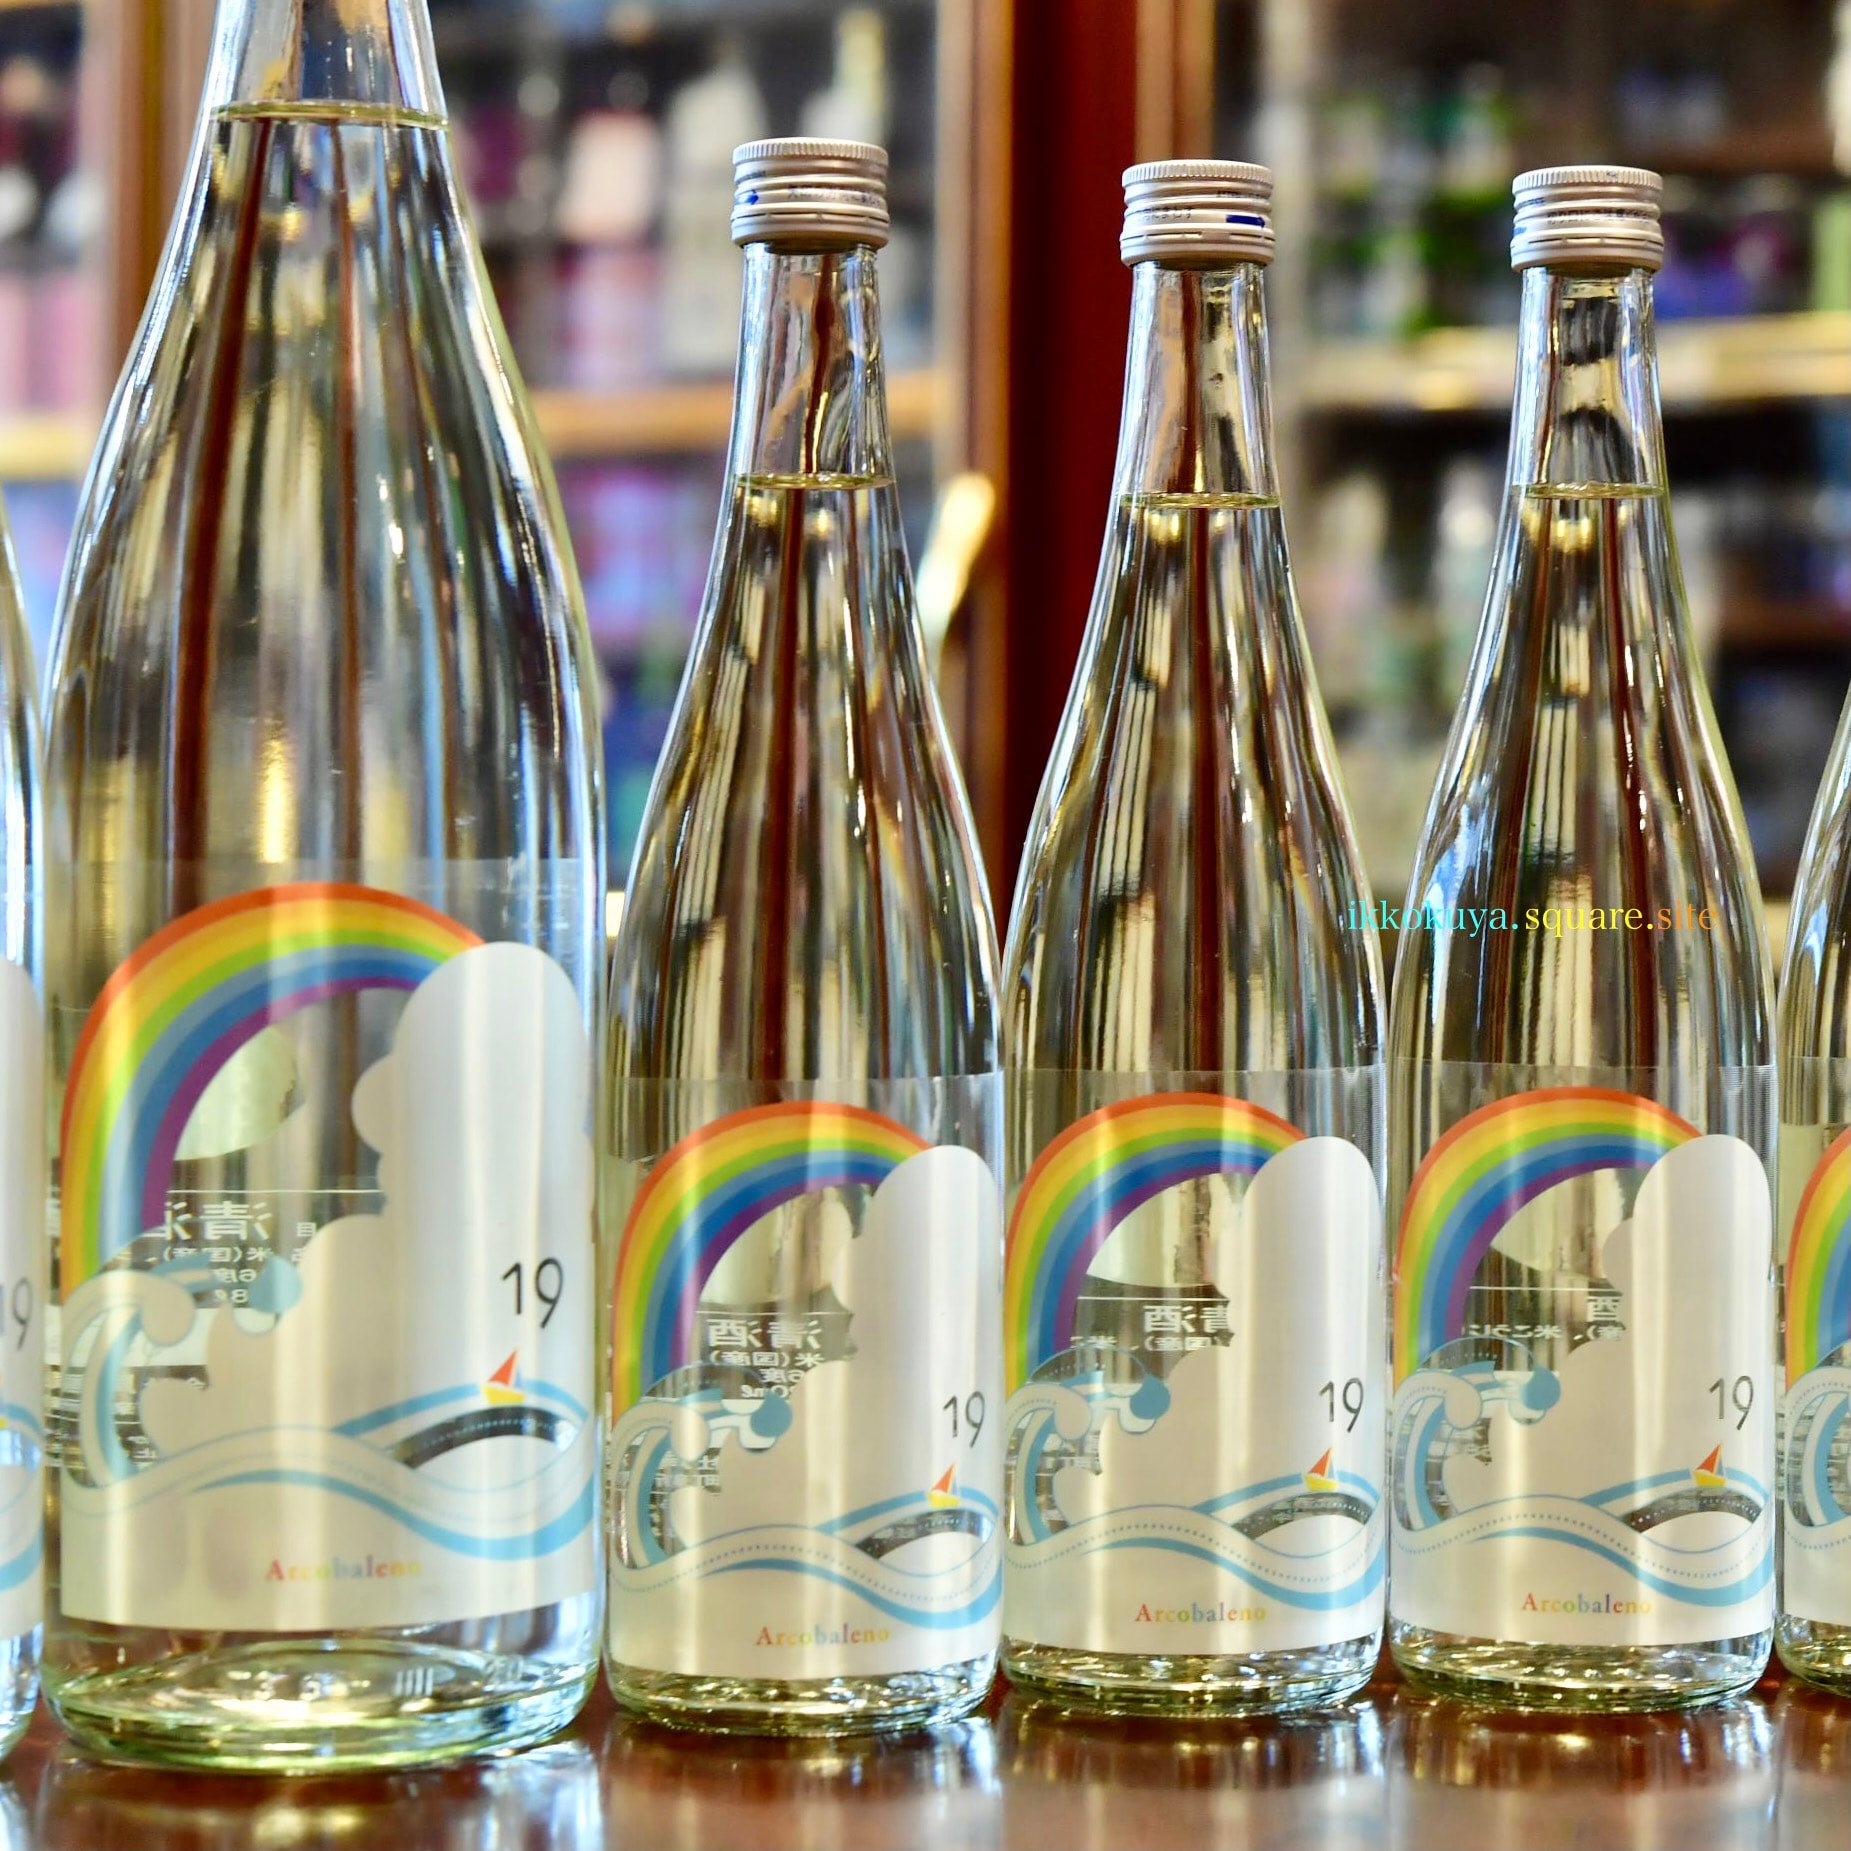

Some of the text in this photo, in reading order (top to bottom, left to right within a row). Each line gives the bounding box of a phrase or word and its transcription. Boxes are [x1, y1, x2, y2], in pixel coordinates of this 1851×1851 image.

[502, 1257, 565, 1330] 19
[942, 1391, 986, 1448] 19
[1318, 1377, 1364, 1434] 19
[1708, 1375, 1755, 1431] 19
[265, 1558, 424, 1584] Arcobaleno
[1135, 1603, 1269, 1625] Arcobaleno
[1521, 1592, 1654, 1615] Arcobaleno
[754, 1623, 892, 1648] Arcobaleno
